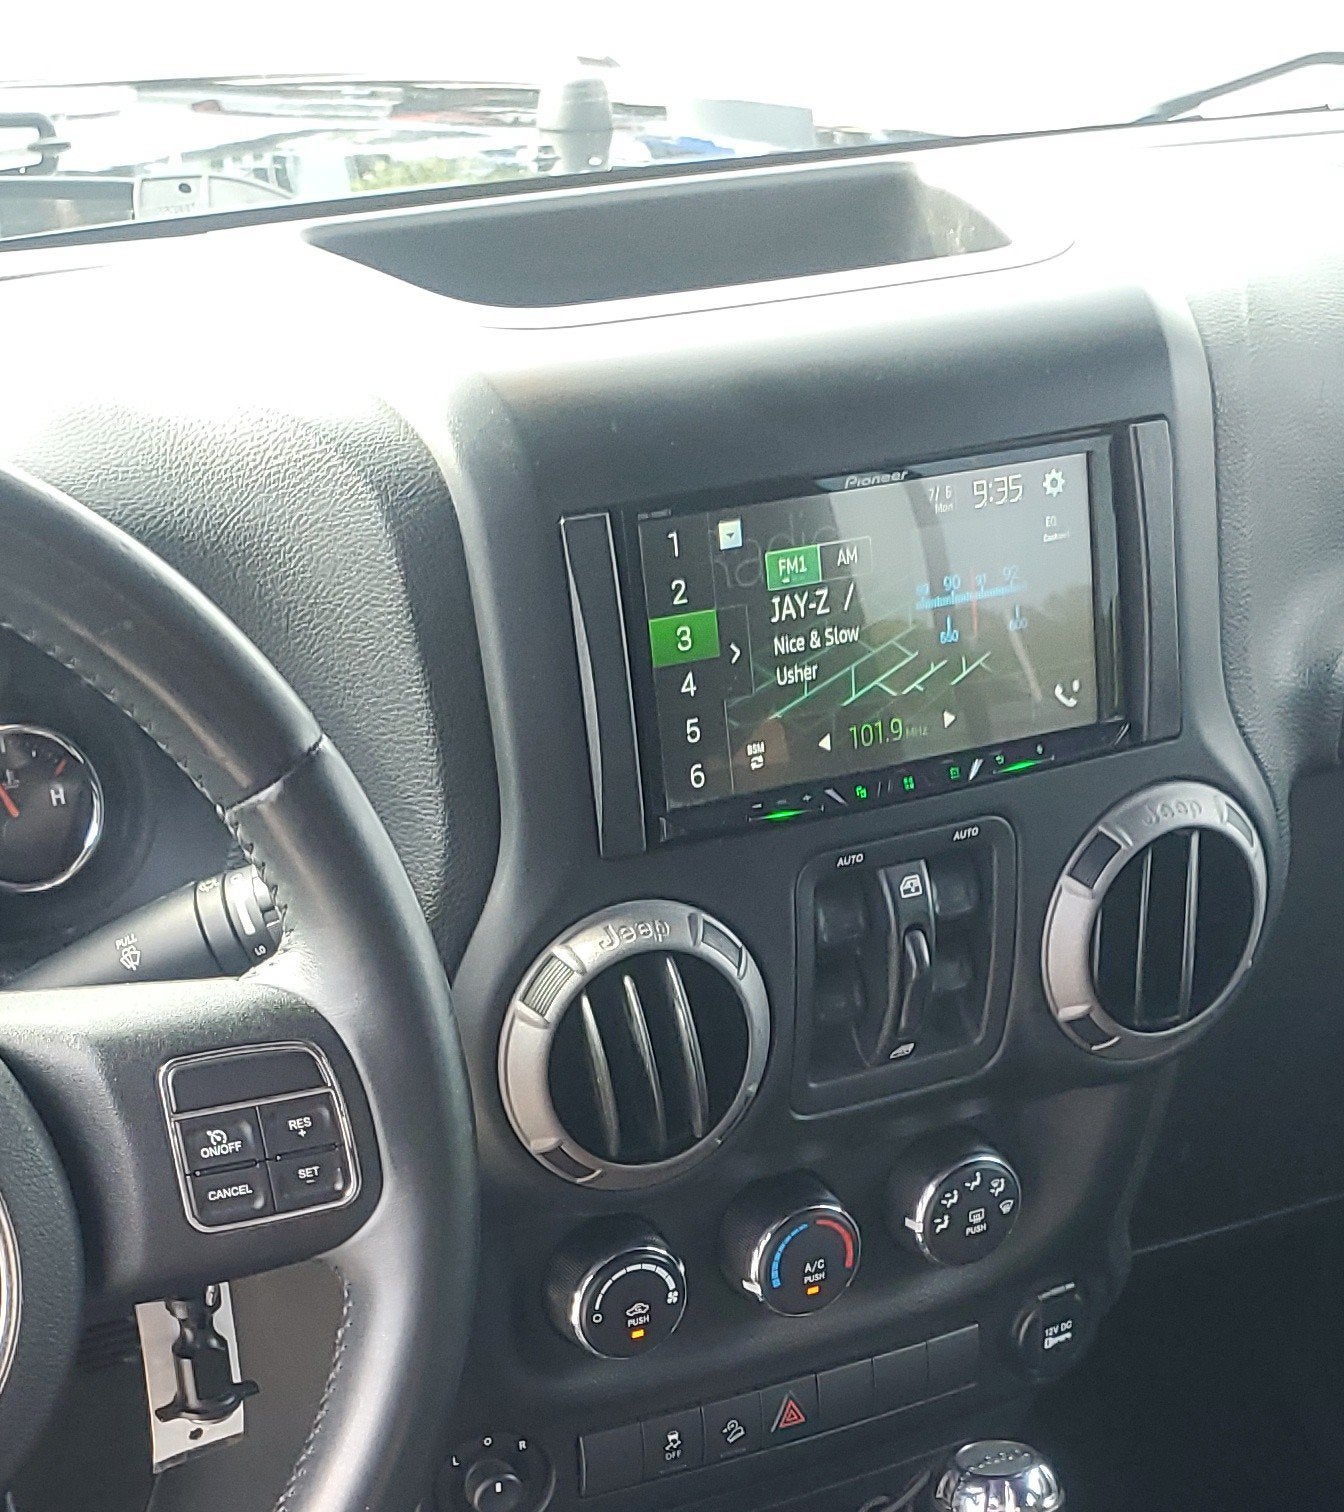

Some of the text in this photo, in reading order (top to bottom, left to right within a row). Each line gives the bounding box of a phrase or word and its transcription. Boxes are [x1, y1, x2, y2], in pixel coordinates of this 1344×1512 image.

[844, 470, 908, 489] Pioneer
[973, 473, 1023, 509] 9:35
[667, 531, 679, 558] 1
[778, 546, 858, 577] FM1 AM
[670, 579, 688, 605] 2
[769, 588, 831, 623] JAY-Z
[676, 626, 692, 652] 3
[773, 625, 860, 657] Nice & Slow
[681, 671, 697, 697] 4
[776, 663, 818, 686] Usher
[686, 717, 701, 743] 5
[849, 717, 904, 750] 101.9
[690, 763, 705, 788] 6
[50, 788, 66, 807] H
[953, 826, 979, 842] AUTO
[836, 853, 864, 868] AUTO
[115, 933, 138, 950] PULL
[599, 920, 670, 950] Jeep
[288, 1117, 312, 1131] RES
[200, 1140, 243, 1158] ON/OFF
[298, 1166, 321, 1179] SET
[208, 1184, 254, 1201] CANCEL
[966, 1223, 987, 1236] PUSH
[804, 1258, 825, 1274] A/C
[804, 1271, 826, 1284] PUSH
[627, 1315, 650, 1328] PUSH
[1045, 1324, 1059, 1337] 12V
[452, 1455, 459, 1466] L
[519, 1440, 526, 1450] R
[665, 1449, 682, 1461] OFF
